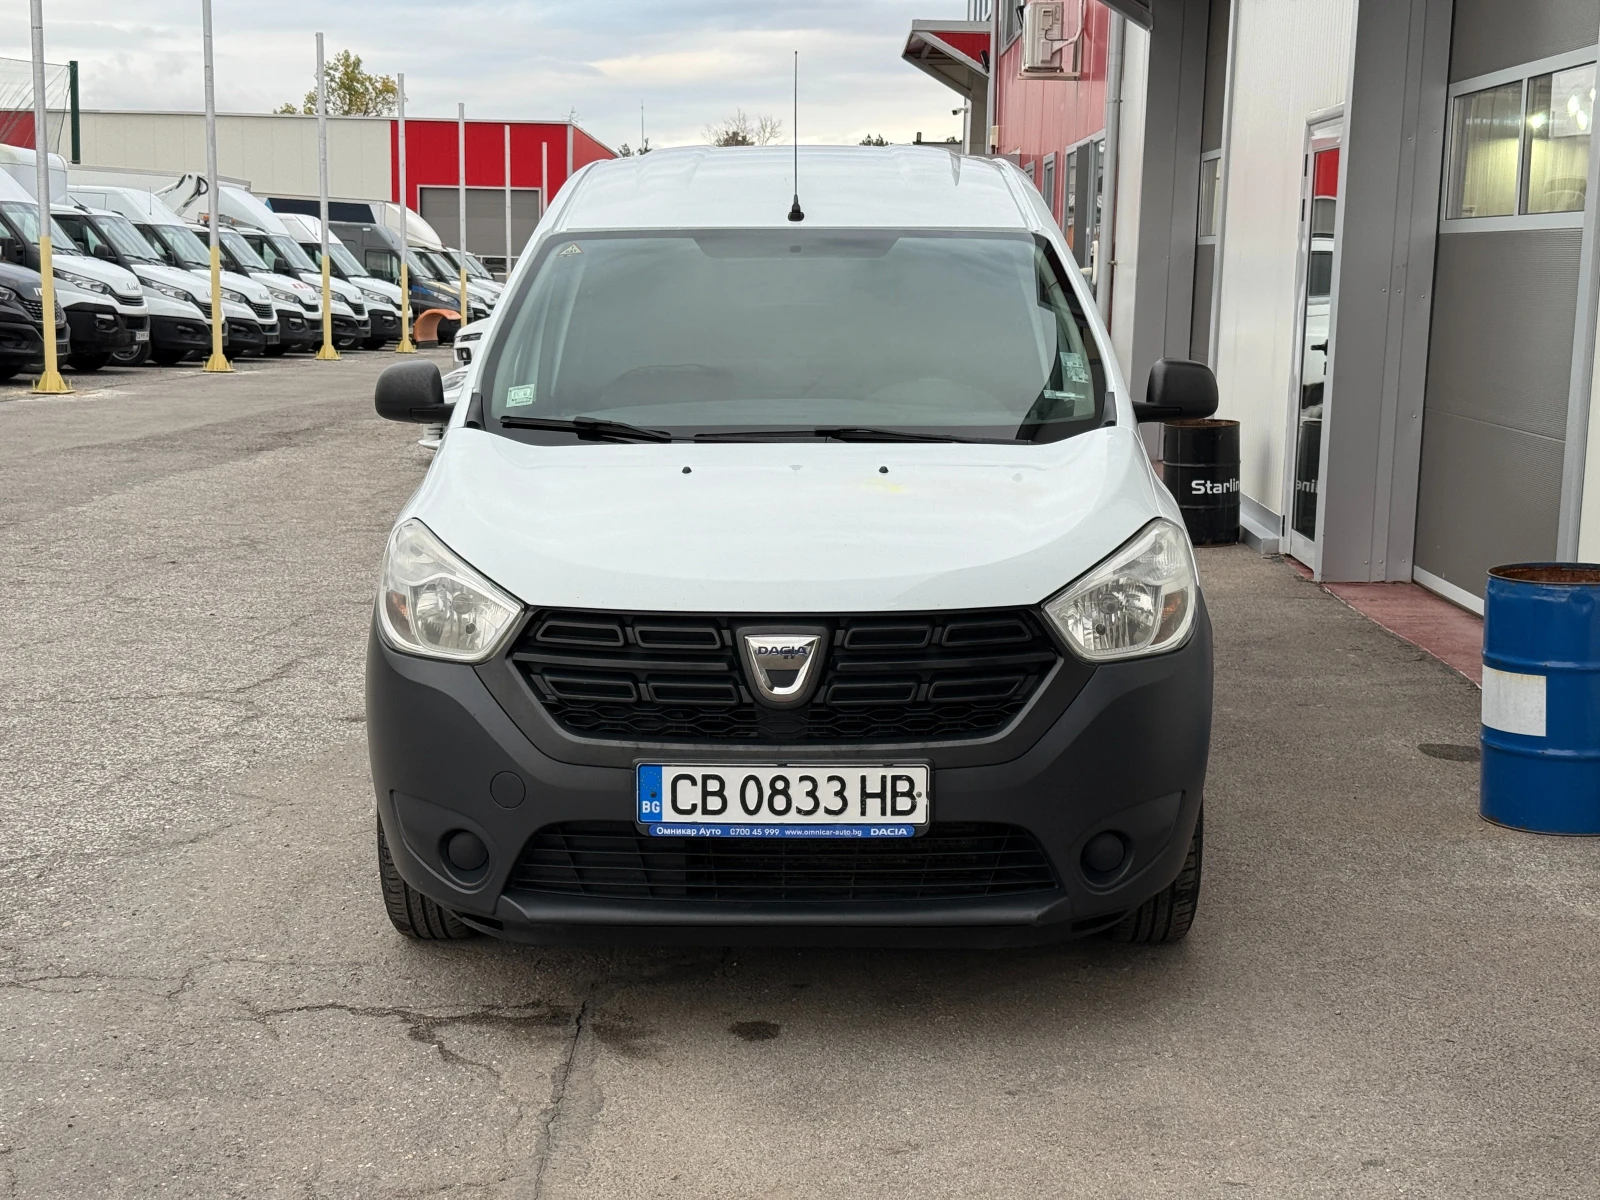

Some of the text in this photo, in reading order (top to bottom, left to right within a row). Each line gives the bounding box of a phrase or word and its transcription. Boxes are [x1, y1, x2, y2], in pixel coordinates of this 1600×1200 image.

[1191, 478, 1240, 495] Starlin
[757, 646, 807, 655] DACIA
[670, 773, 918, 817] CB 0833 HB
[642, 801, 661, 814] BG
[656, 827, 697, 837] Омникар
[699, 827, 721, 837] Ауто
[752, 828, 762, 836] 45
[764, 828, 780, 836] 999
[785, 828, 862, 837] www.omnicar-auto.bg
[870, 828, 908, 836] DACIA
